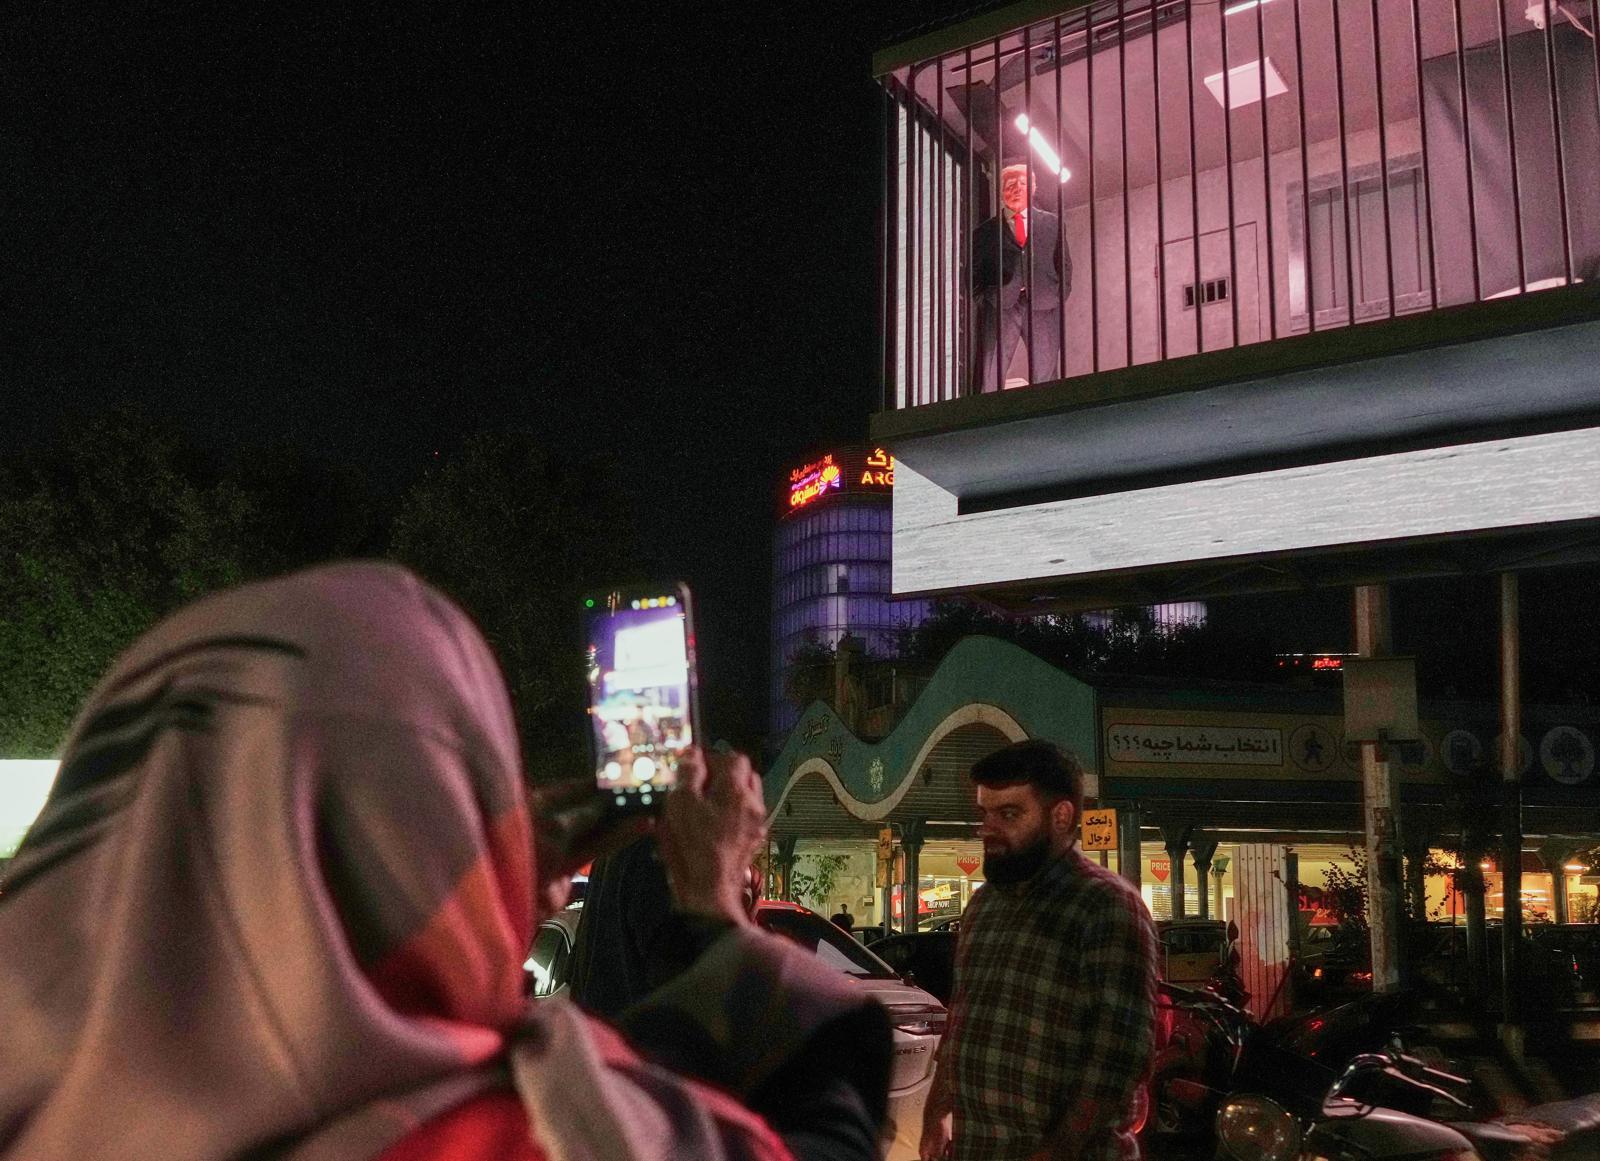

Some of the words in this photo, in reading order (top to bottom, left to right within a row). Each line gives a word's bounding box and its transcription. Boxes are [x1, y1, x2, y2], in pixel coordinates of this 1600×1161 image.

[867, 448, 894, 471] رگ
[861, 471, 894, 485] ARG
[1176, 733, 1212, 752] شما
[1215, 737, 1277, 758] انتخاب
[958, 855, 980, 865] PRICE
